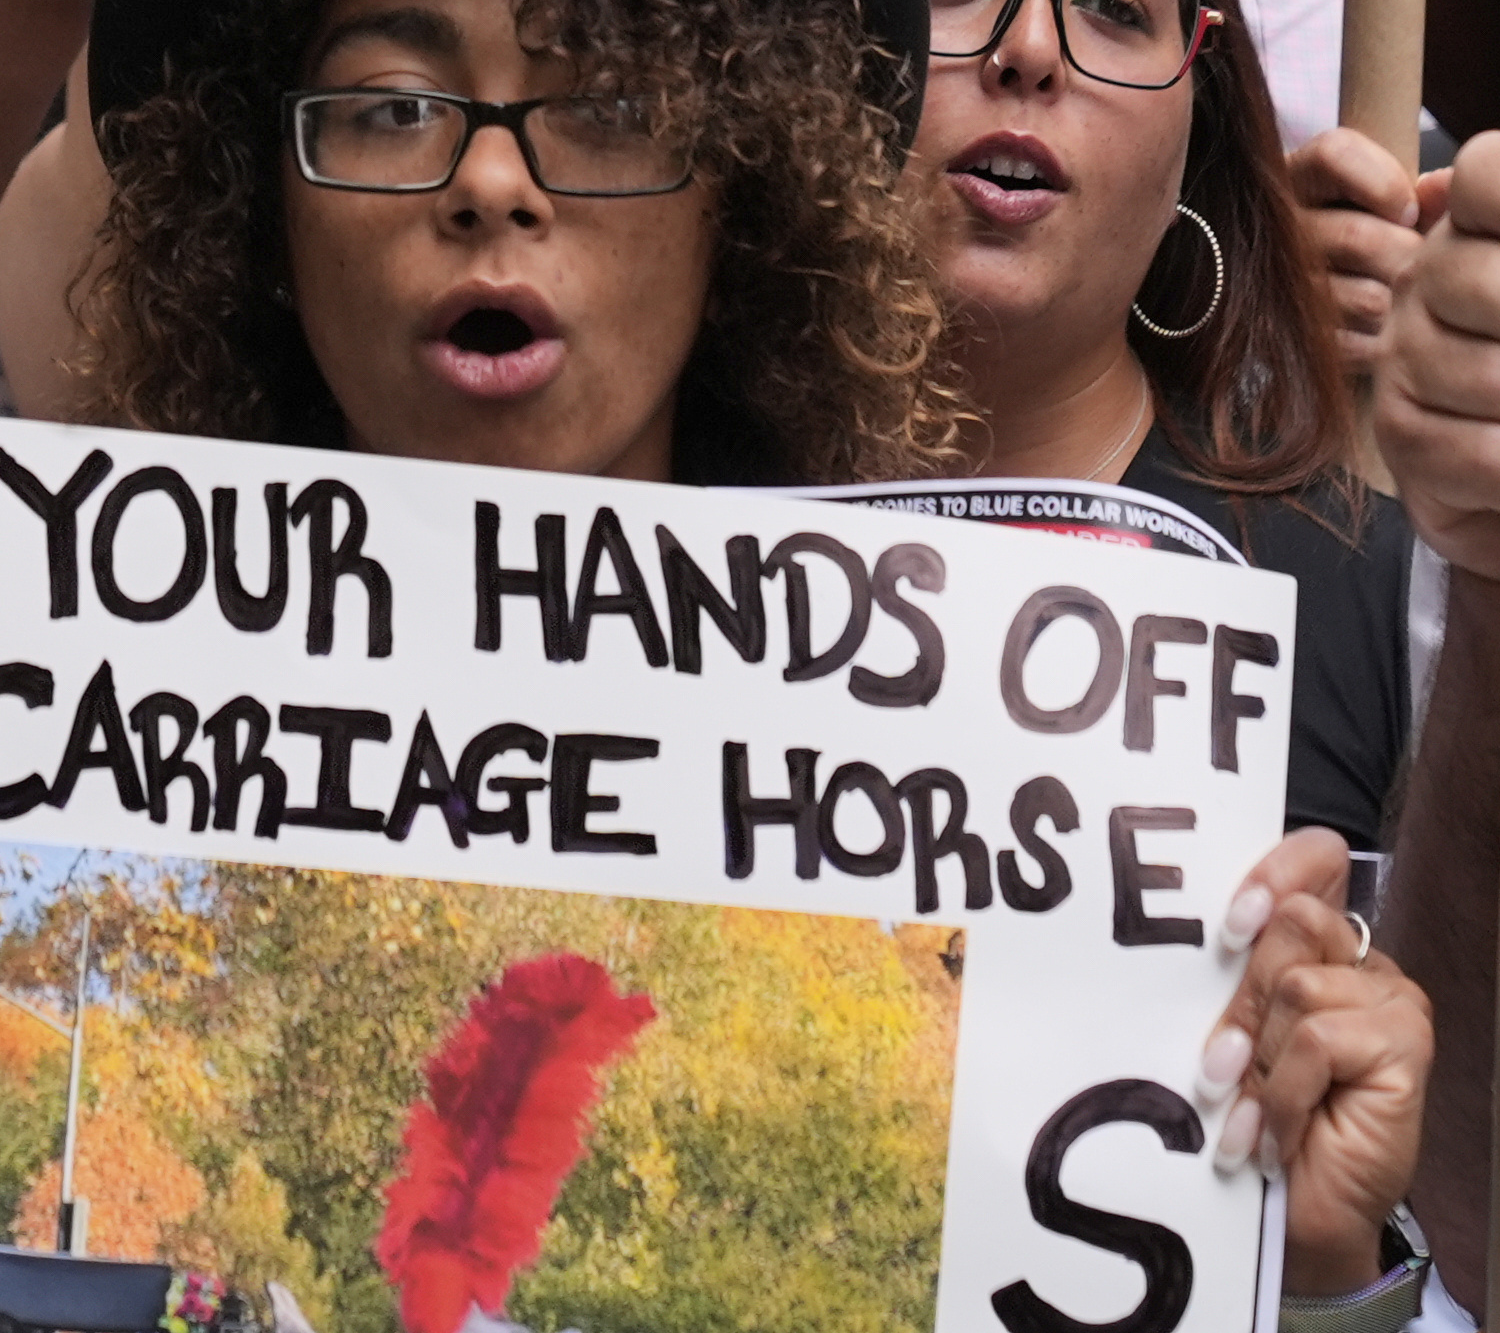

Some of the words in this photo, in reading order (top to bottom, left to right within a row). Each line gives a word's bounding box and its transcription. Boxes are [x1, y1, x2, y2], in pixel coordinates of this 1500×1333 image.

[941, 497, 967, 517] TO
[970, 495, 1024, 517] BLUE
[1029, 496, 1122, 525] COLLAR
[1124, 507, 1218, 562] WORKERS
[473, 498, 948, 709] HANDS
[998, 583, 1281, 774] OFF
[722, 740, 1206, 947] HORSE
